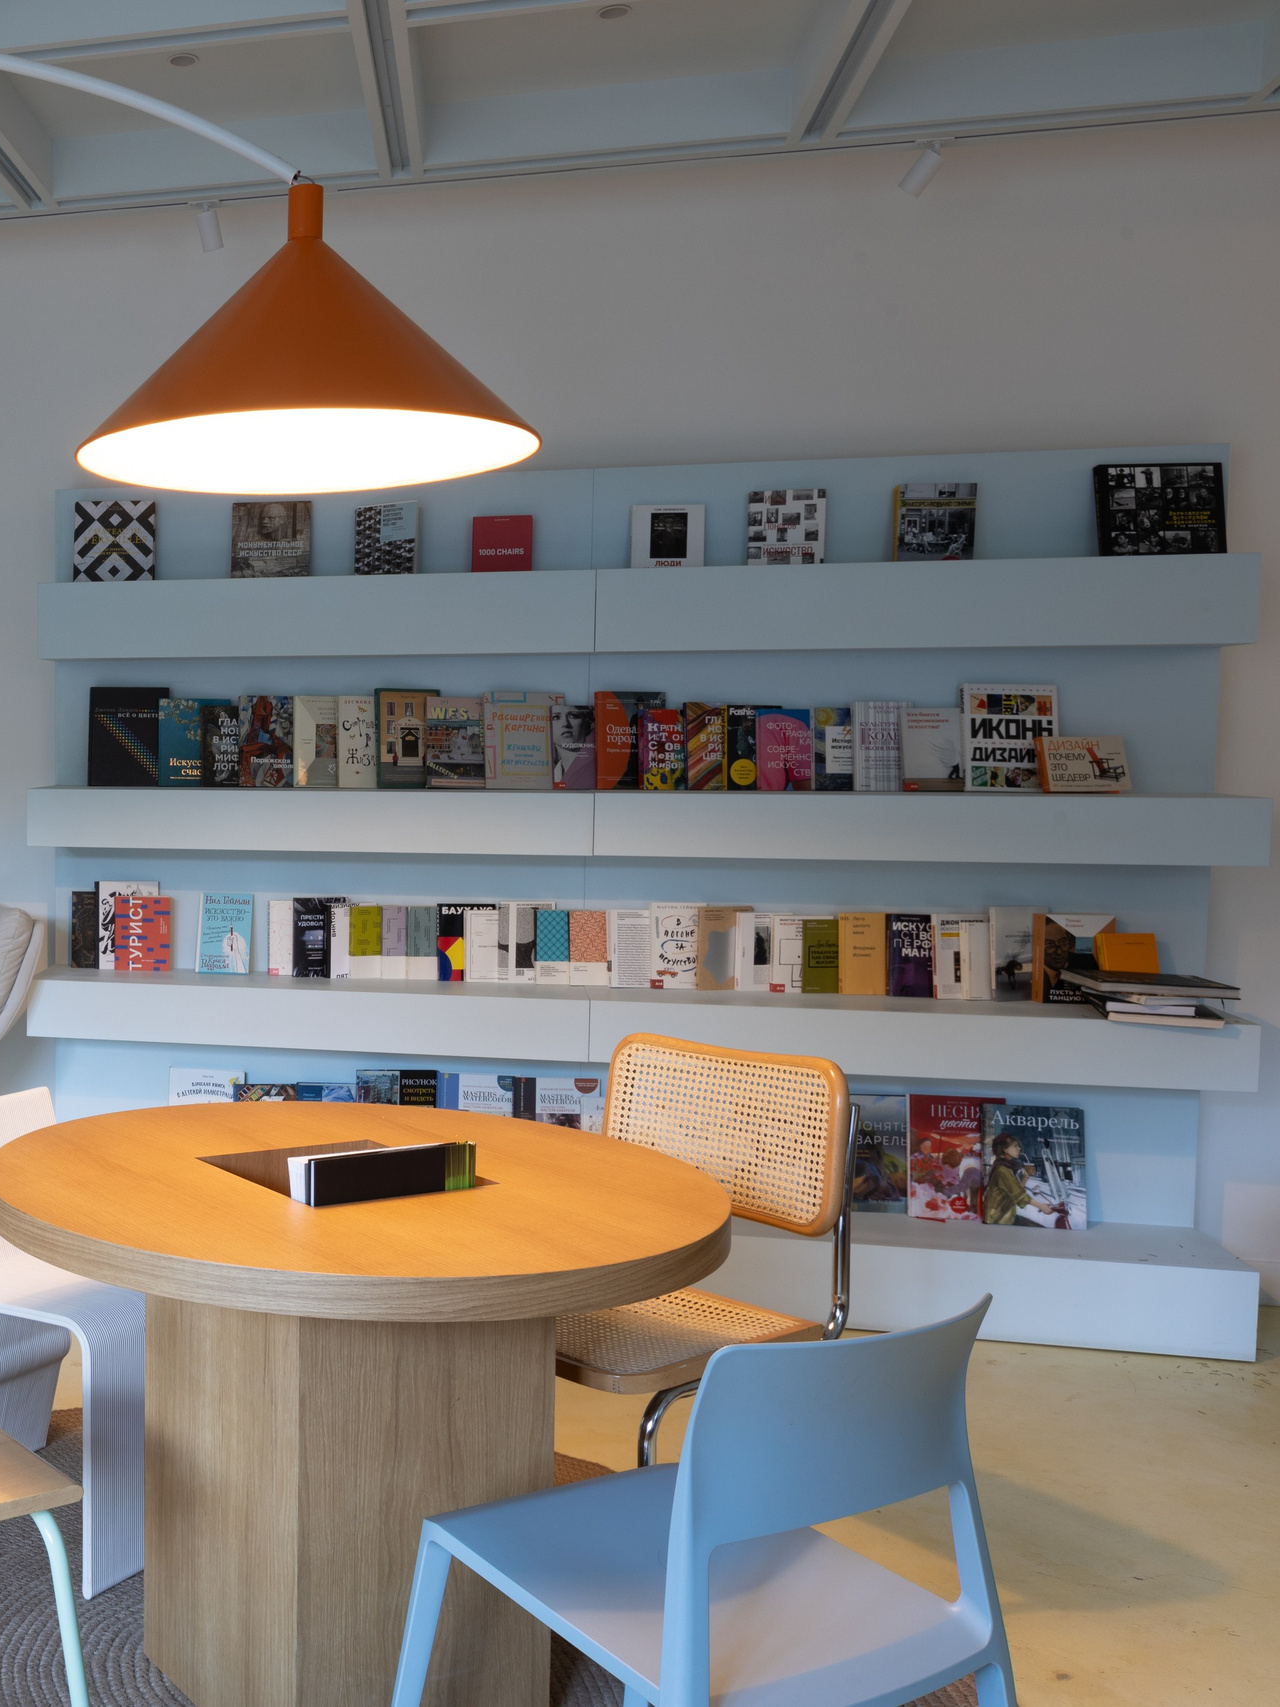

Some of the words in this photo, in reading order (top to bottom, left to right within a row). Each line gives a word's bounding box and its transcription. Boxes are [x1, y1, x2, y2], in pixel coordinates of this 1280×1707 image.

[237, 540, 305, 549] МОНУМЕНТАЛЬНОЕ
[237, 549, 282, 558] ИСКУССТВО
[478, 548, 495, 557] 1000
[496, 547, 525, 556] CHAIRS
[218, 718, 239, 726] ГЛА
[606, 724, 639, 735] Одева
[213, 736, 220, 744] В
[222, 736, 239, 744] ИС
[607, 735, 637, 746] город
[700, 734, 707, 742] В
[1047, 738, 1101, 752] ДИЗАЙН
[250, 757, 291, 766] Парижская
[1048, 752, 1087, 762] ПОЧЕМУ
[426, 761, 458, 780] COLLECTION
[1050, 762, 1069, 772] ЭТО
[1052, 773, 1092, 784] ШЕДЕВР
[205, 895, 222, 905] Нил
[222, 896, 251, 906] Гейман
[676, 918, 682, 927] В
[129, 896, 143, 971] ТУРИСТ
[664, 929, 696, 938] ПОГОНЕ
[401, 1078, 438, 1087] РИСУНОК
[402, 1088, 436, 1096] смотреть
[462, 1090, 498, 1098] MASTERS
[540, 1093, 575, 1101] MASTERS
[939, 1118, 978, 1131] цвета
[990, 1110, 1081, 1132] Акварель
